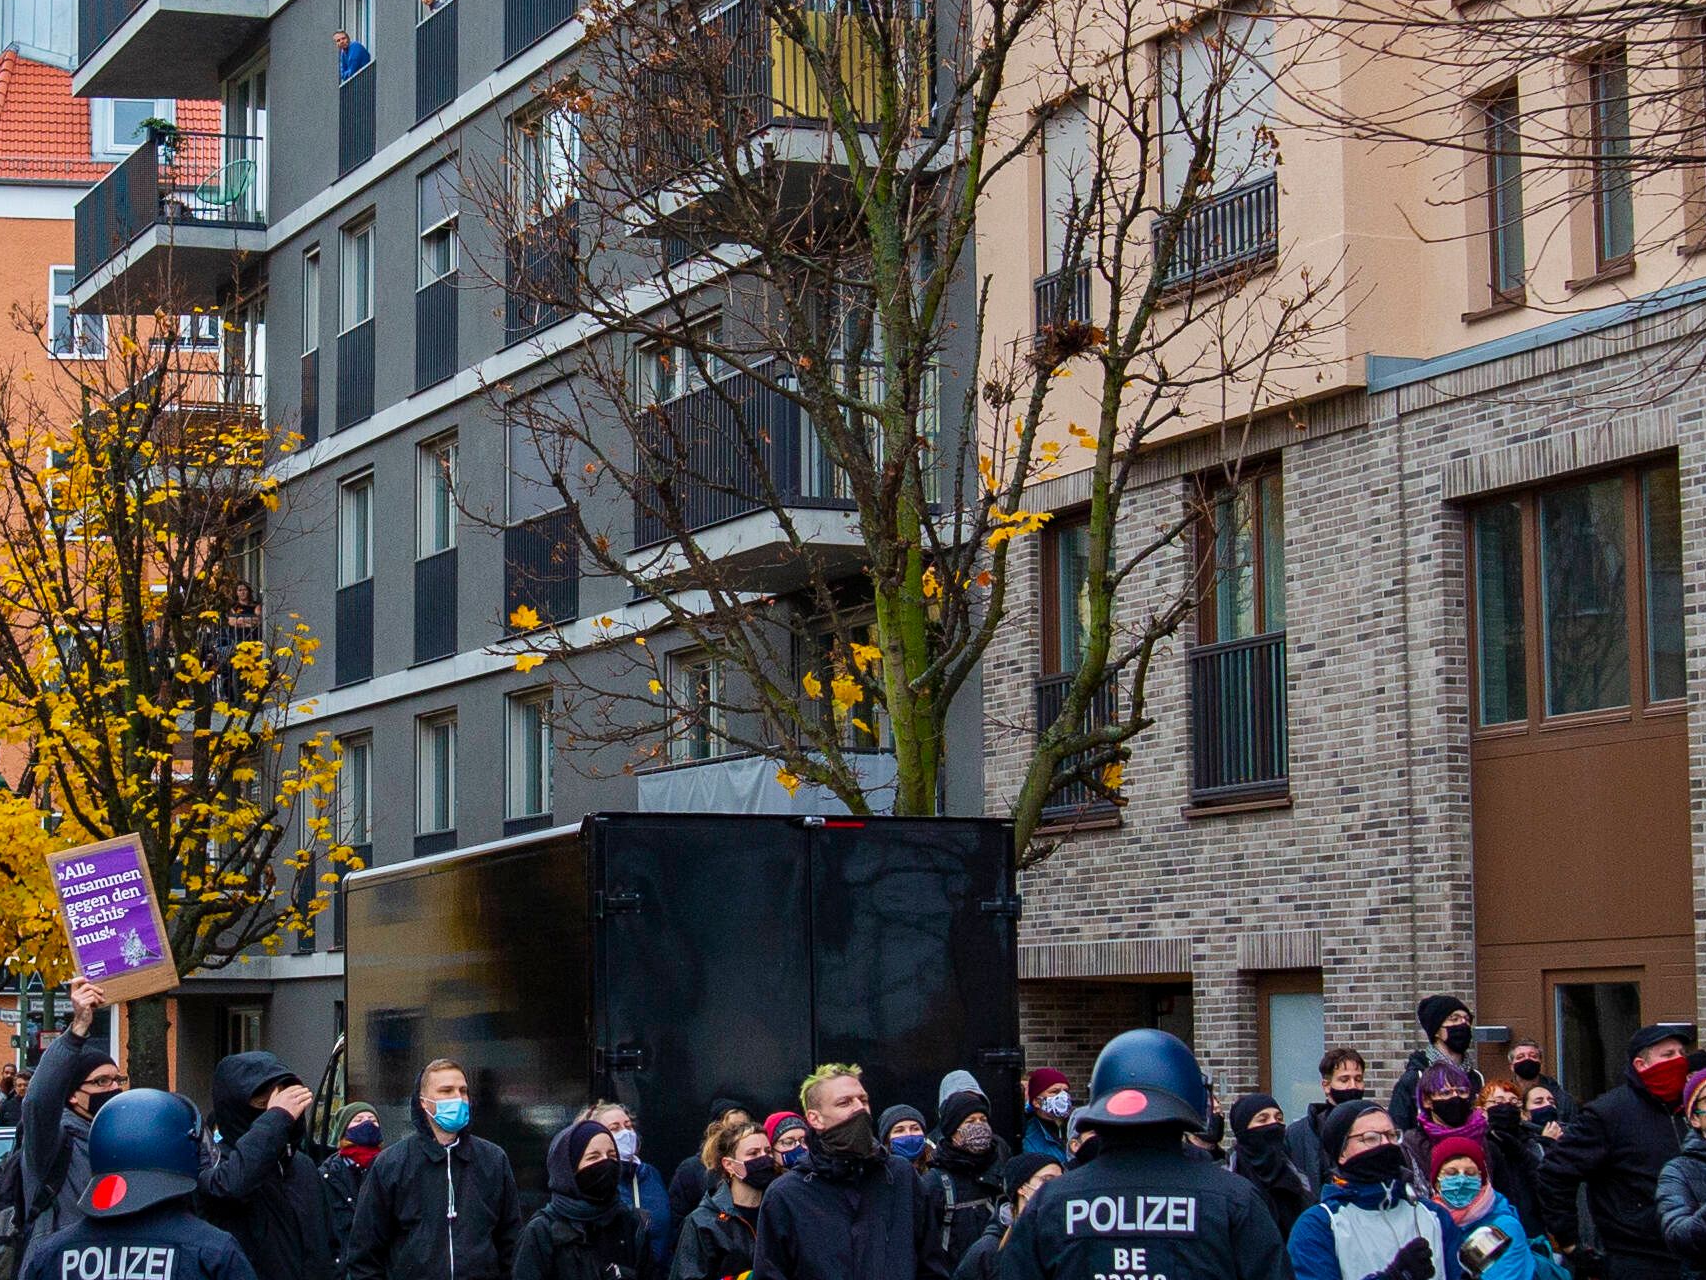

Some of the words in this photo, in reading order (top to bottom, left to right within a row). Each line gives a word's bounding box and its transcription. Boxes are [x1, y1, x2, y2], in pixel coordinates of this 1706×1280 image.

[57, 862, 96, 881] »Alle
[62, 869, 143, 899] zusammen
[66, 895, 111, 917] gegen
[112, 887, 141, 901] den
[69, 906, 130, 931] Faschis-
[74, 926, 117, 947] mus!«
[1066, 1196, 1196, 1235] POLIZEI
[1114, 1248, 1147, 1270] BE
